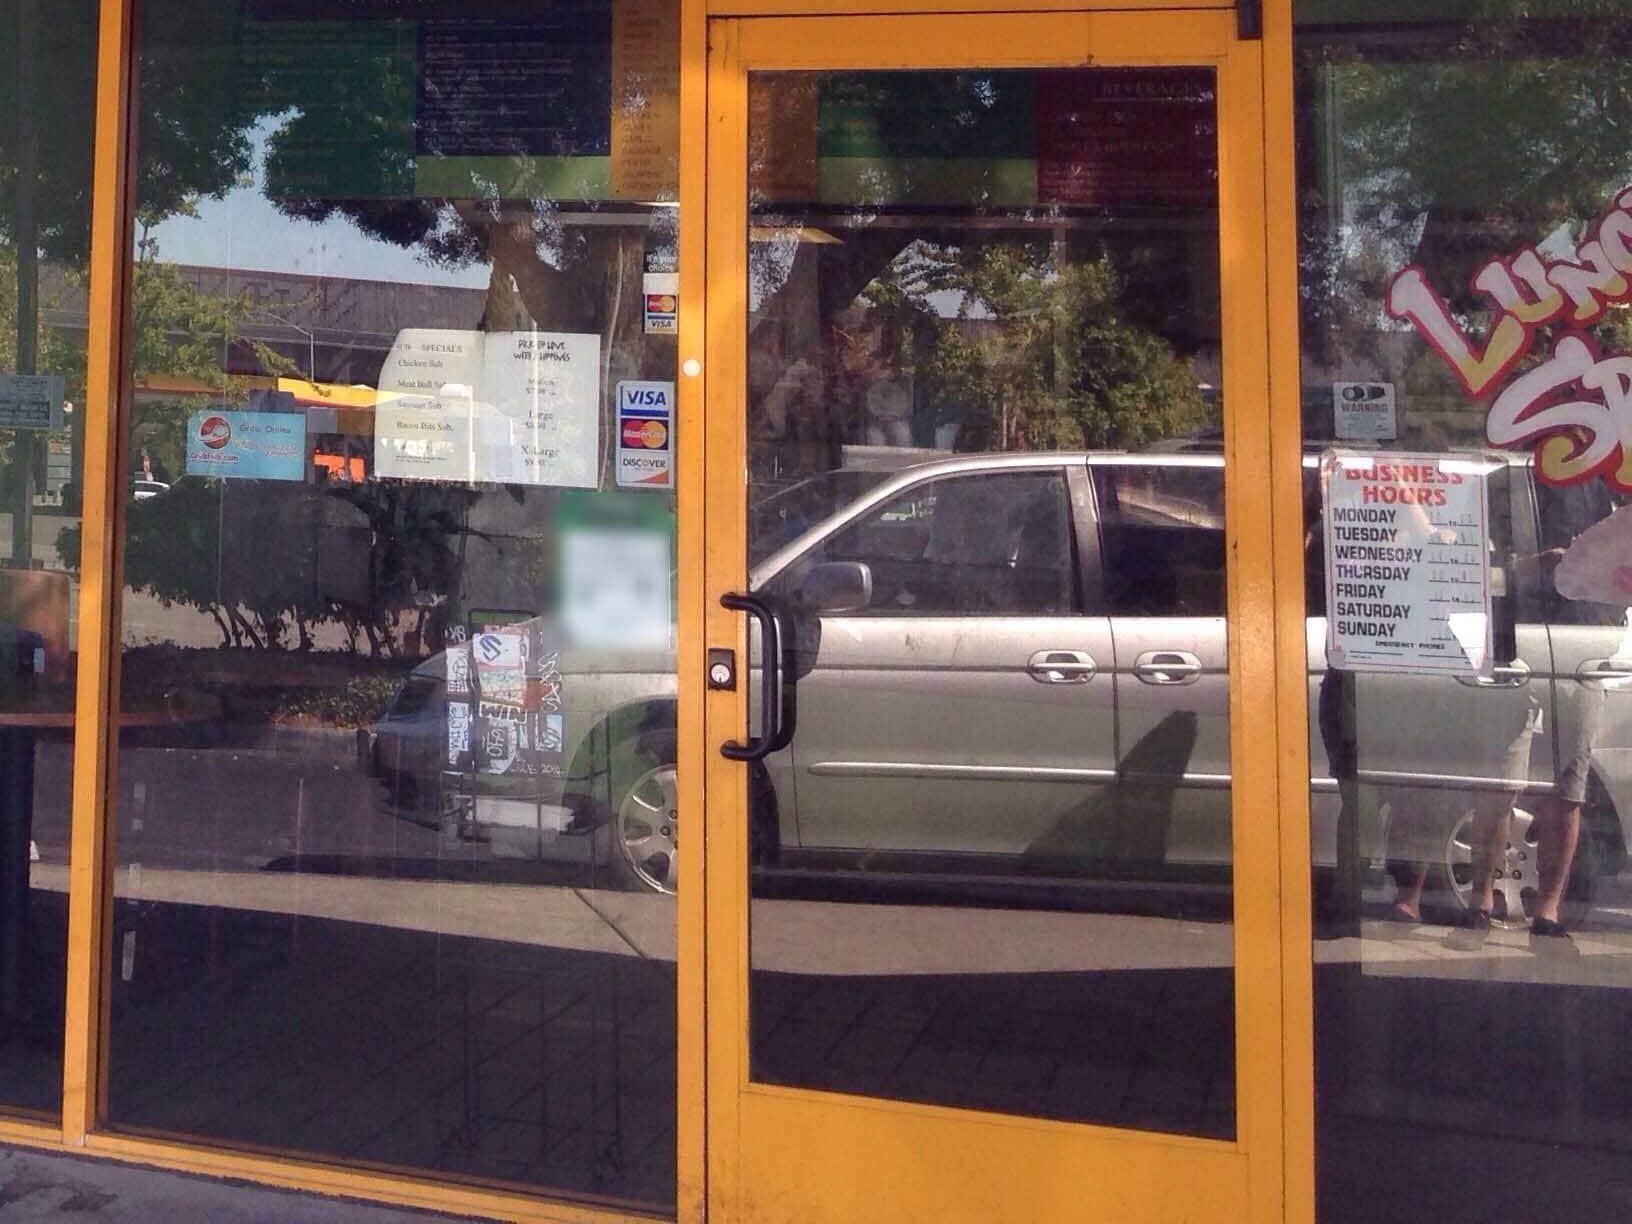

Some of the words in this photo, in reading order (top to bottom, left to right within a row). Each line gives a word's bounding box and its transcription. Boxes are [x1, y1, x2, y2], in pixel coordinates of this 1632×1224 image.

[1385, 185, 1632, 399] LUNC
[628, 390, 666, 406] VISA
[1341, 402, 1388, 414] WARNING
[622, 458, 667, 468] DISCOVER
[1362, 485, 1448, 506] HOURS
[1334, 507, 1396, 523] MONDAY
[1335, 526, 1398, 543] TUESDAY
[1335, 545, 1423, 563] WEDNESDAY
[1336, 564, 1411, 581] THURSDAY
[1336, 583, 1386, 599] FRIDAY
[1337, 602, 1411, 619] SATURDAY
[1337, 620, 1397, 637] SUNDAY
